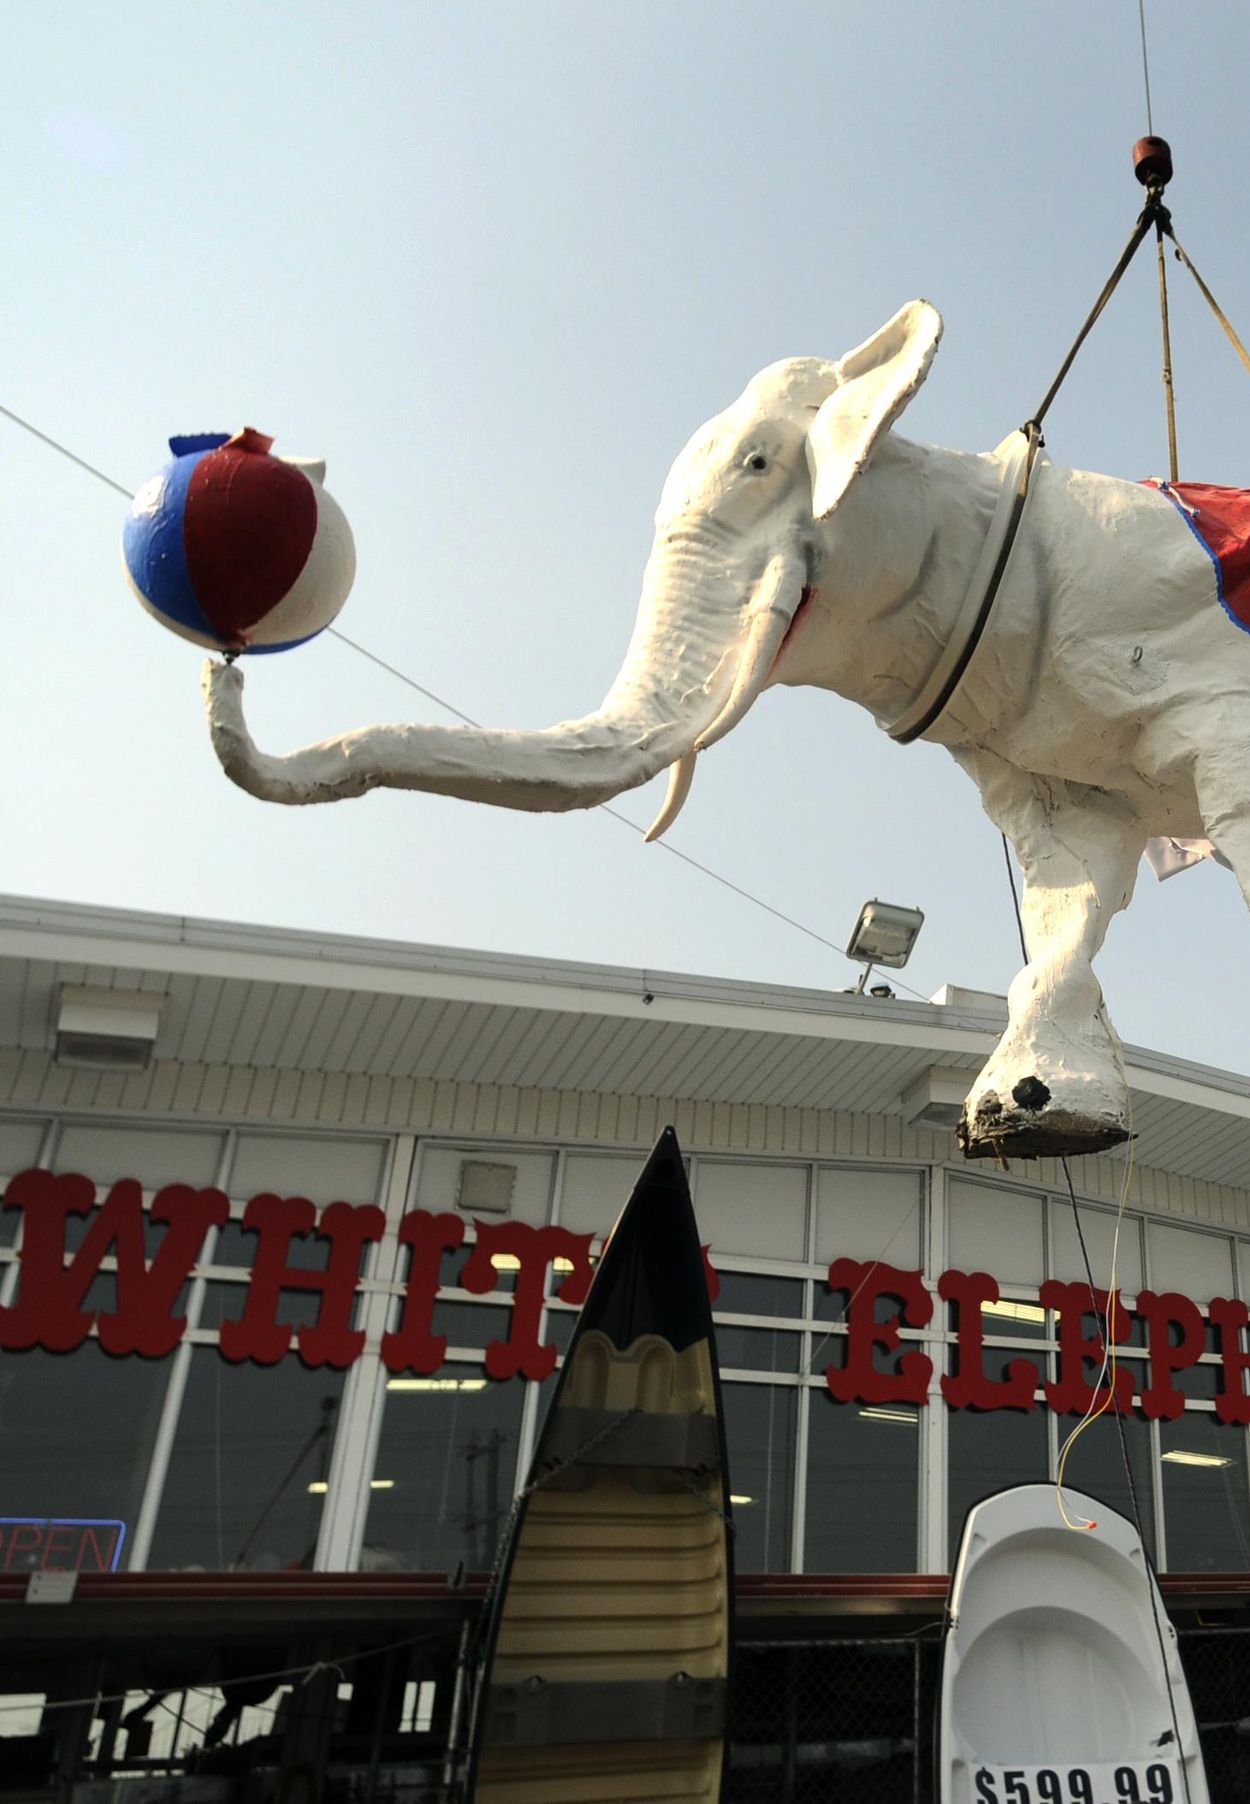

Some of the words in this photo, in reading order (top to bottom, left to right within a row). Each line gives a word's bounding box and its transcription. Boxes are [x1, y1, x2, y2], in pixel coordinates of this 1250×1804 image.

[0, 1168, 720, 1382] WHIT
[0, 1525, 119, 1573] PEN
[975, 1763, 1174, 1804] $59999
